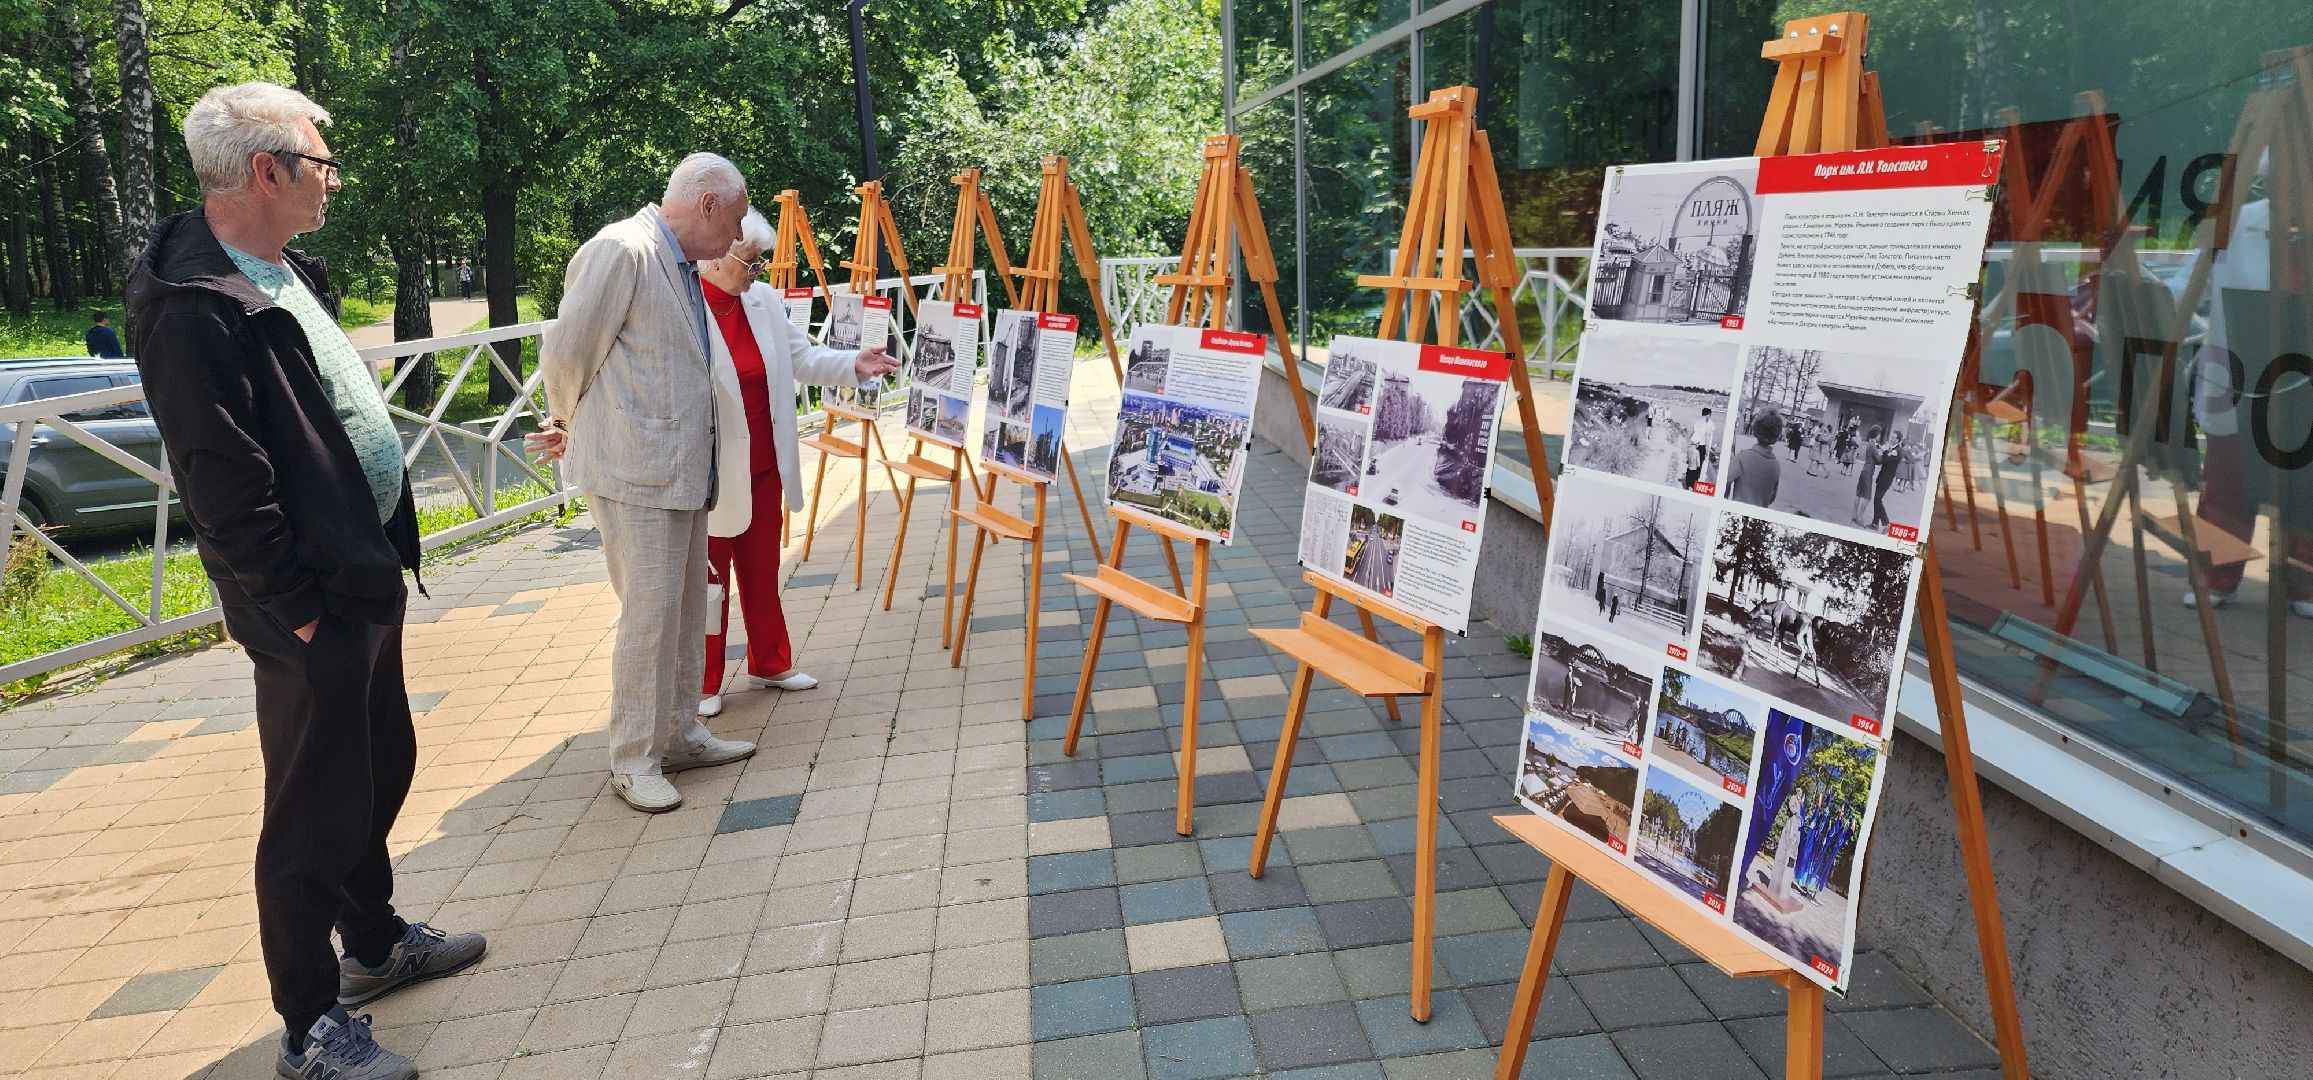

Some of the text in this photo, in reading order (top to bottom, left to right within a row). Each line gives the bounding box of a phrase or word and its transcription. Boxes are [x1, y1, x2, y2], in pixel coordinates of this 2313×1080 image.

[1814, 160, 1928, 179] Парк им. Л.Н. Толстого
[1690, 199, 1739, 217] ПЛЯЖ
[1857, 718, 1874, 731] 1964
